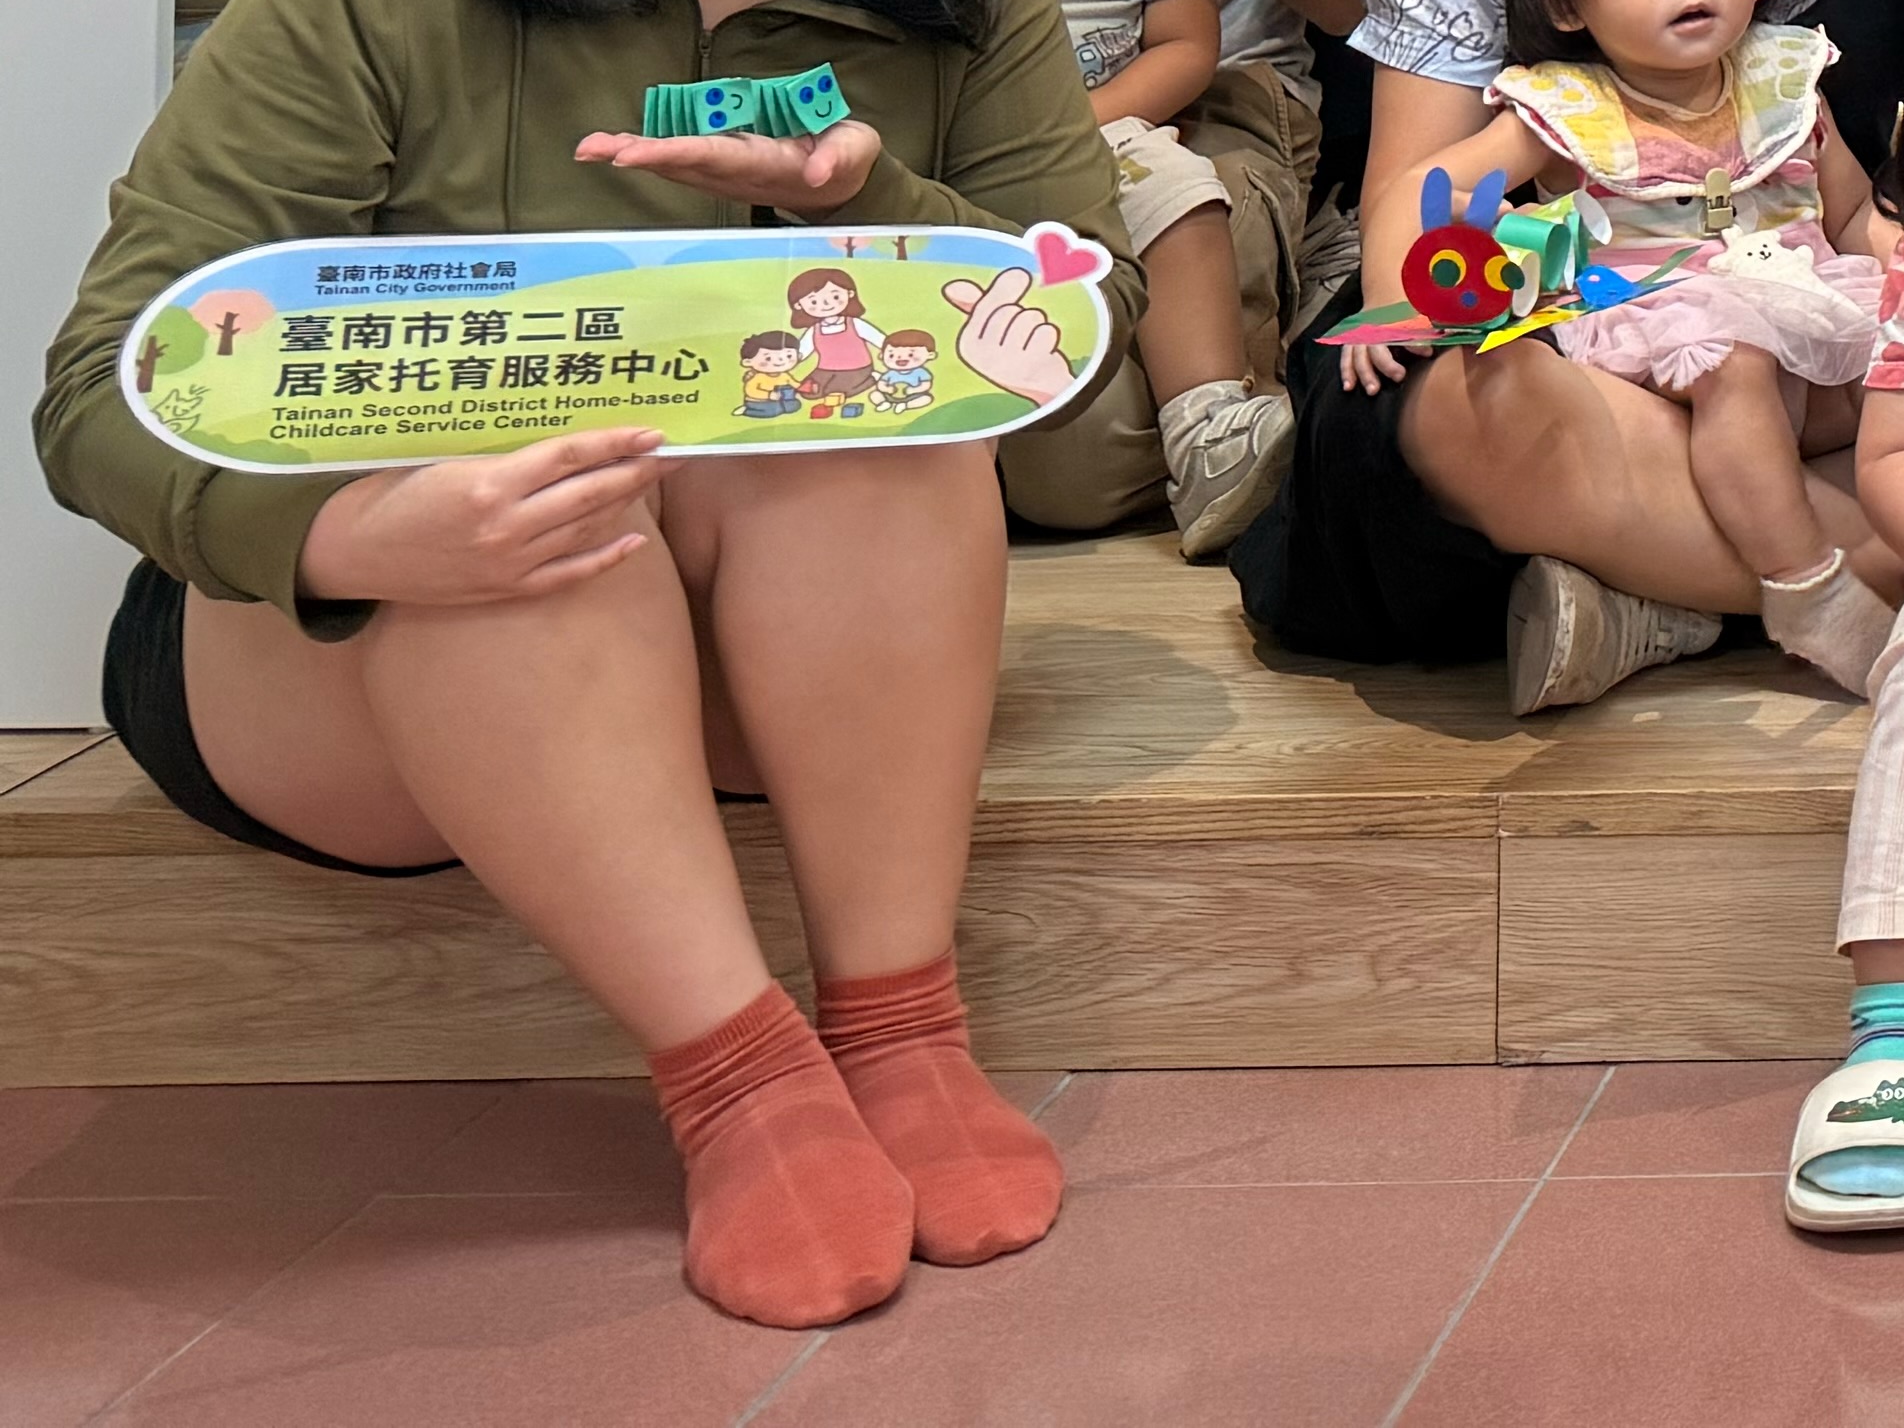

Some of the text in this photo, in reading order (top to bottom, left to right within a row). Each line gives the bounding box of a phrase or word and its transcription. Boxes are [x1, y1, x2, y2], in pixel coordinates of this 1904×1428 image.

[317, 261, 517, 282] 臺南市政府社會局
[315, 281, 516, 295] Tainan City Government
[279, 306, 625, 352] 臺南市第二區
[274, 349, 709, 397] 居家托育服務中心
[272, 390, 699, 421] Tainan Second District Home-based
[270, 414, 573, 439] Childcare Service Center
